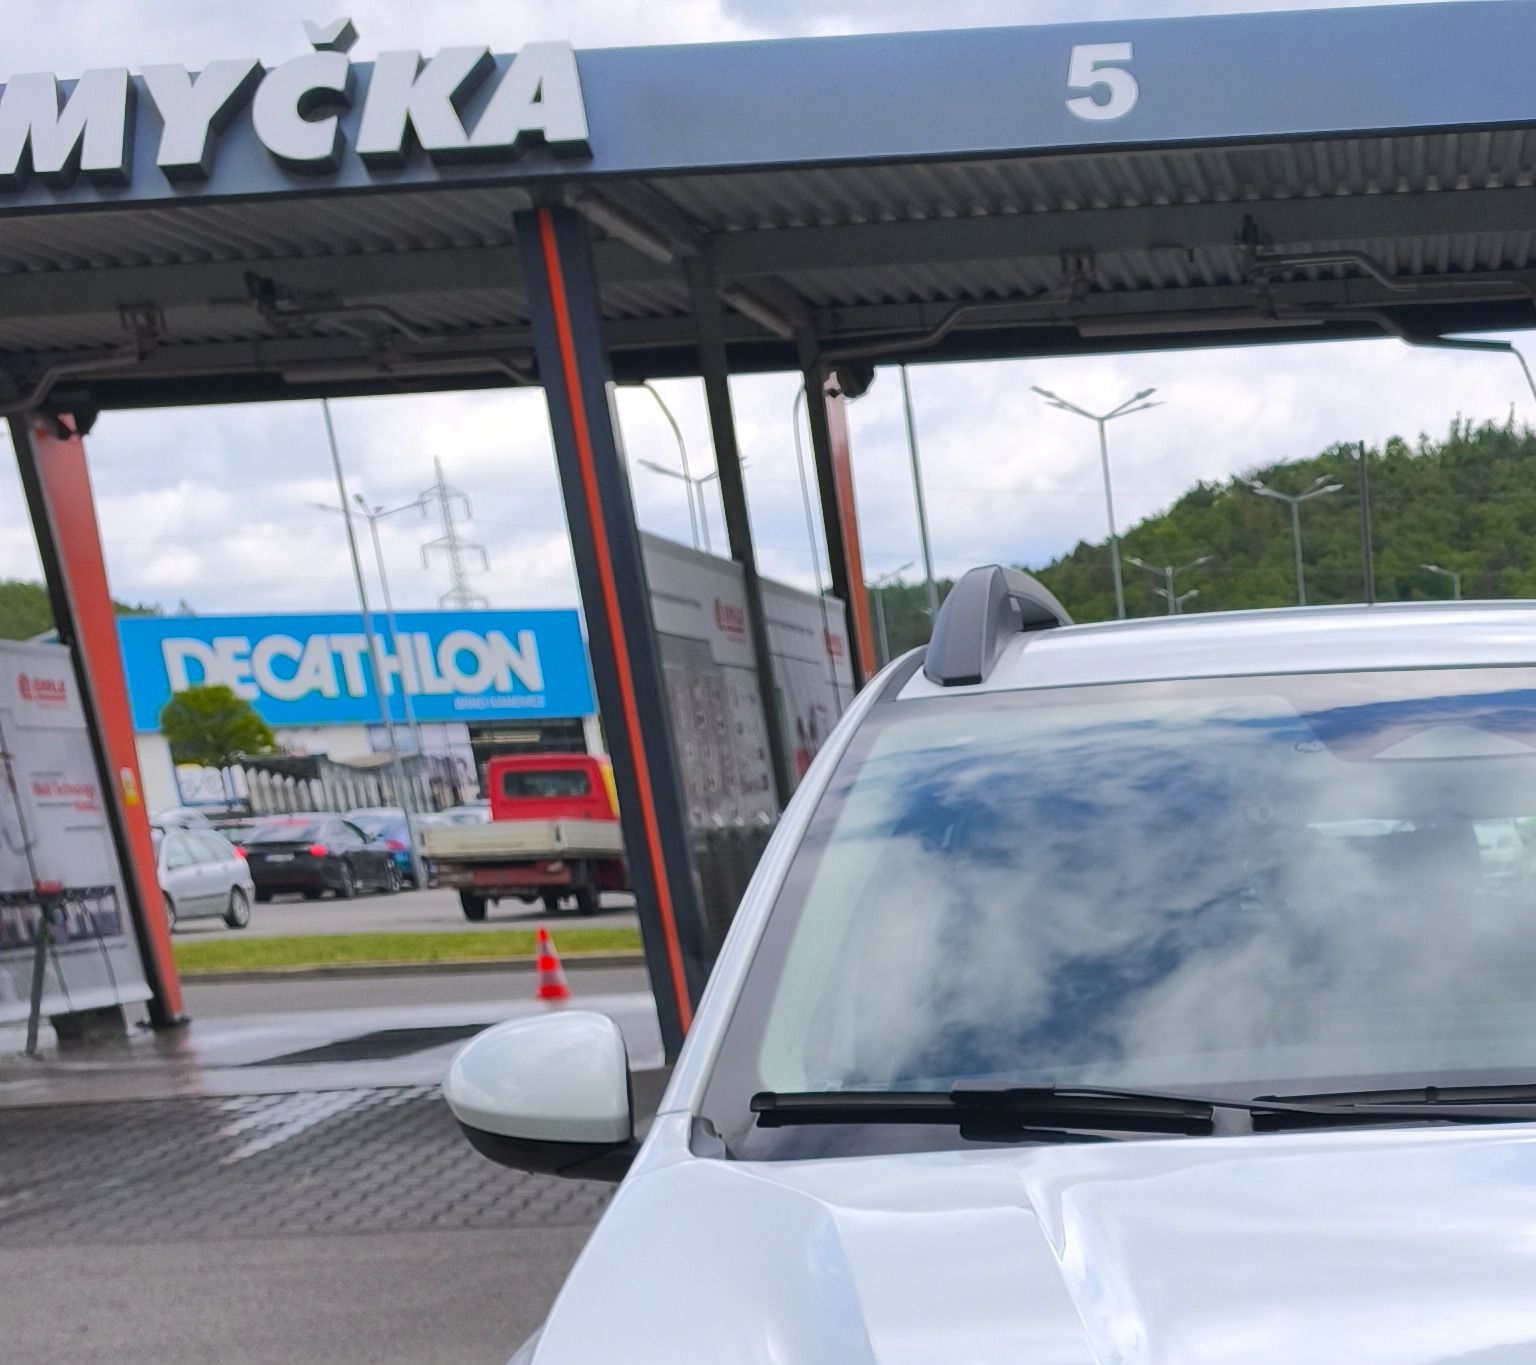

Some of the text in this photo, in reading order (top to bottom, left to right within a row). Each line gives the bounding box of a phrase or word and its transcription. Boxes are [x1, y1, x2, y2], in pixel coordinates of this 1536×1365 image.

[0, 17, 592, 187] MYČKA
[1064, 41, 1140, 121] 5
[161, 629, 545, 700] DECATHLON
